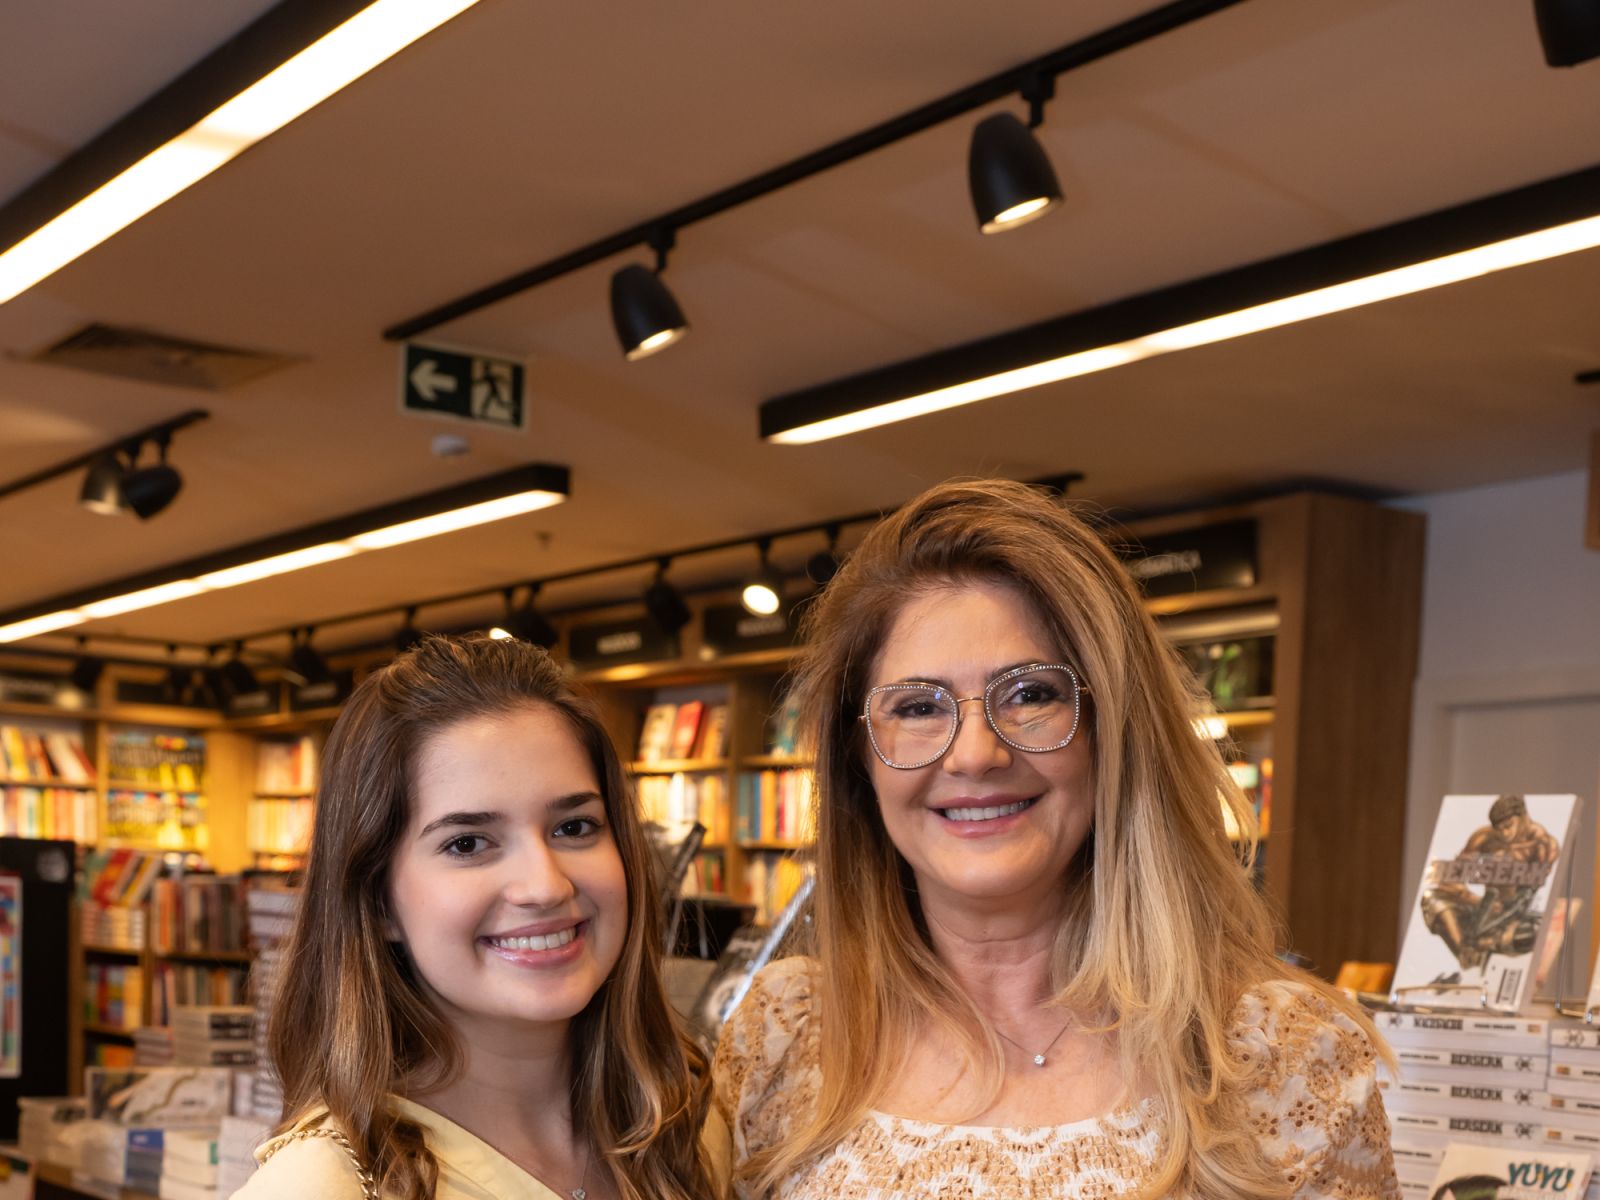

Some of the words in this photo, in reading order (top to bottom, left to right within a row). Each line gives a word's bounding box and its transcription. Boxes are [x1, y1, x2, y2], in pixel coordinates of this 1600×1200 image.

[1451, 1053, 1503, 1068] BERSERK
[1451, 1086, 1502, 1101] BERSERK
[1449, 1118, 1502, 1134] BERSERK
[1508, 1163, 1575, 1192] YUYU
